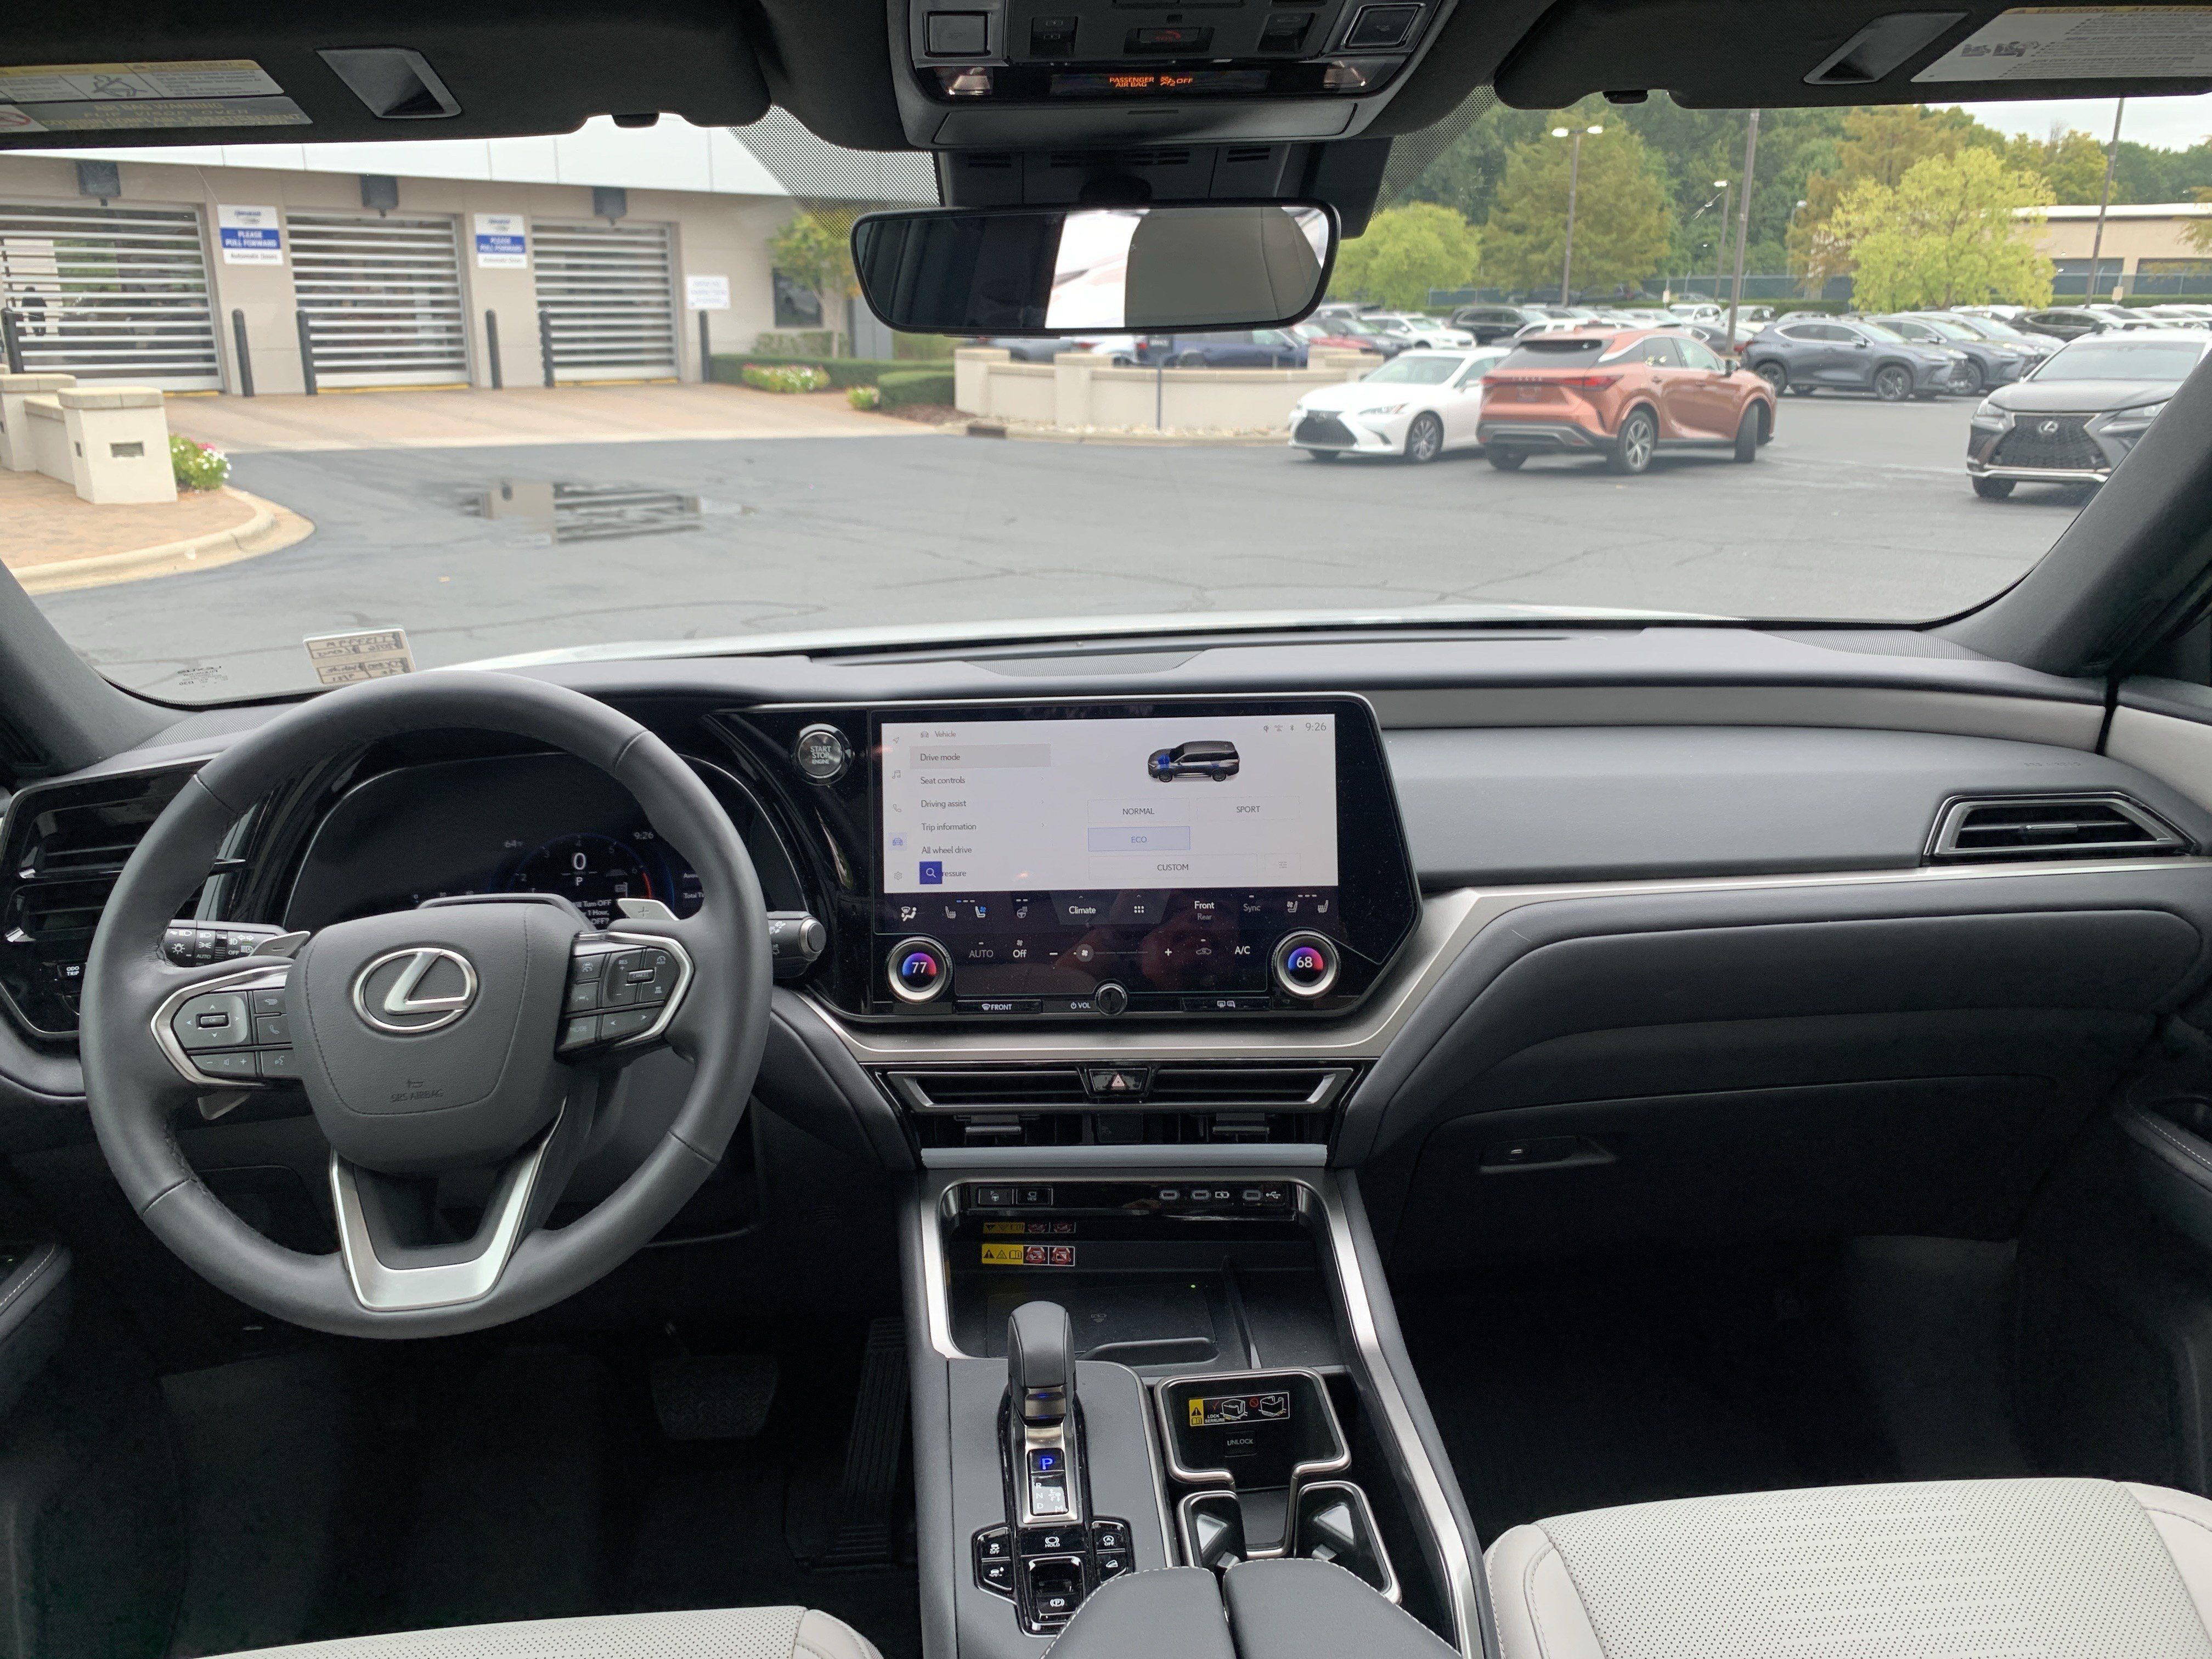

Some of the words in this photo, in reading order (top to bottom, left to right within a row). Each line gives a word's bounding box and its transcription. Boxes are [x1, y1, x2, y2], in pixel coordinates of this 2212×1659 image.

[1305, 722, 1327, 731] 9:26
[920, 753, 939, 761] Drive
[938, 776, 966, 784] controls
[921, 799, 946, 809] Driving
[947, 799, 967, 808] assist
[1122, 808, 1155, 816] NORMAL
[922, 823, 935, 832] Trip
[634, 831, 654, 840] 9:26
[1131, 836, 1148, 844] ECO
[921, 846, 931, 854] All
[932, 845, 953, 854] wheel
[955, 845, 972, 854] drive
[572, 851, 587, 871] 0
[575, 876, 583, 887] P
[1194, 901, 1215, 910] Front
[1243, 904, 1261, 912] Sync
[1069, 906, 1097, 915] Climate
[969, 950, 994, 958] AUTO
[1013, 949, 1027, 958] Off
[1234, 946, 1250, 955] A/C
[1296, 956, 1313, 968] 68
[912, 962, 927, 974] 77
[390, 1092, 409, 1102] SRS
[410, 1089, 444, 1101] AIRBAG
[1041, 1457, 1053, 1470] P
